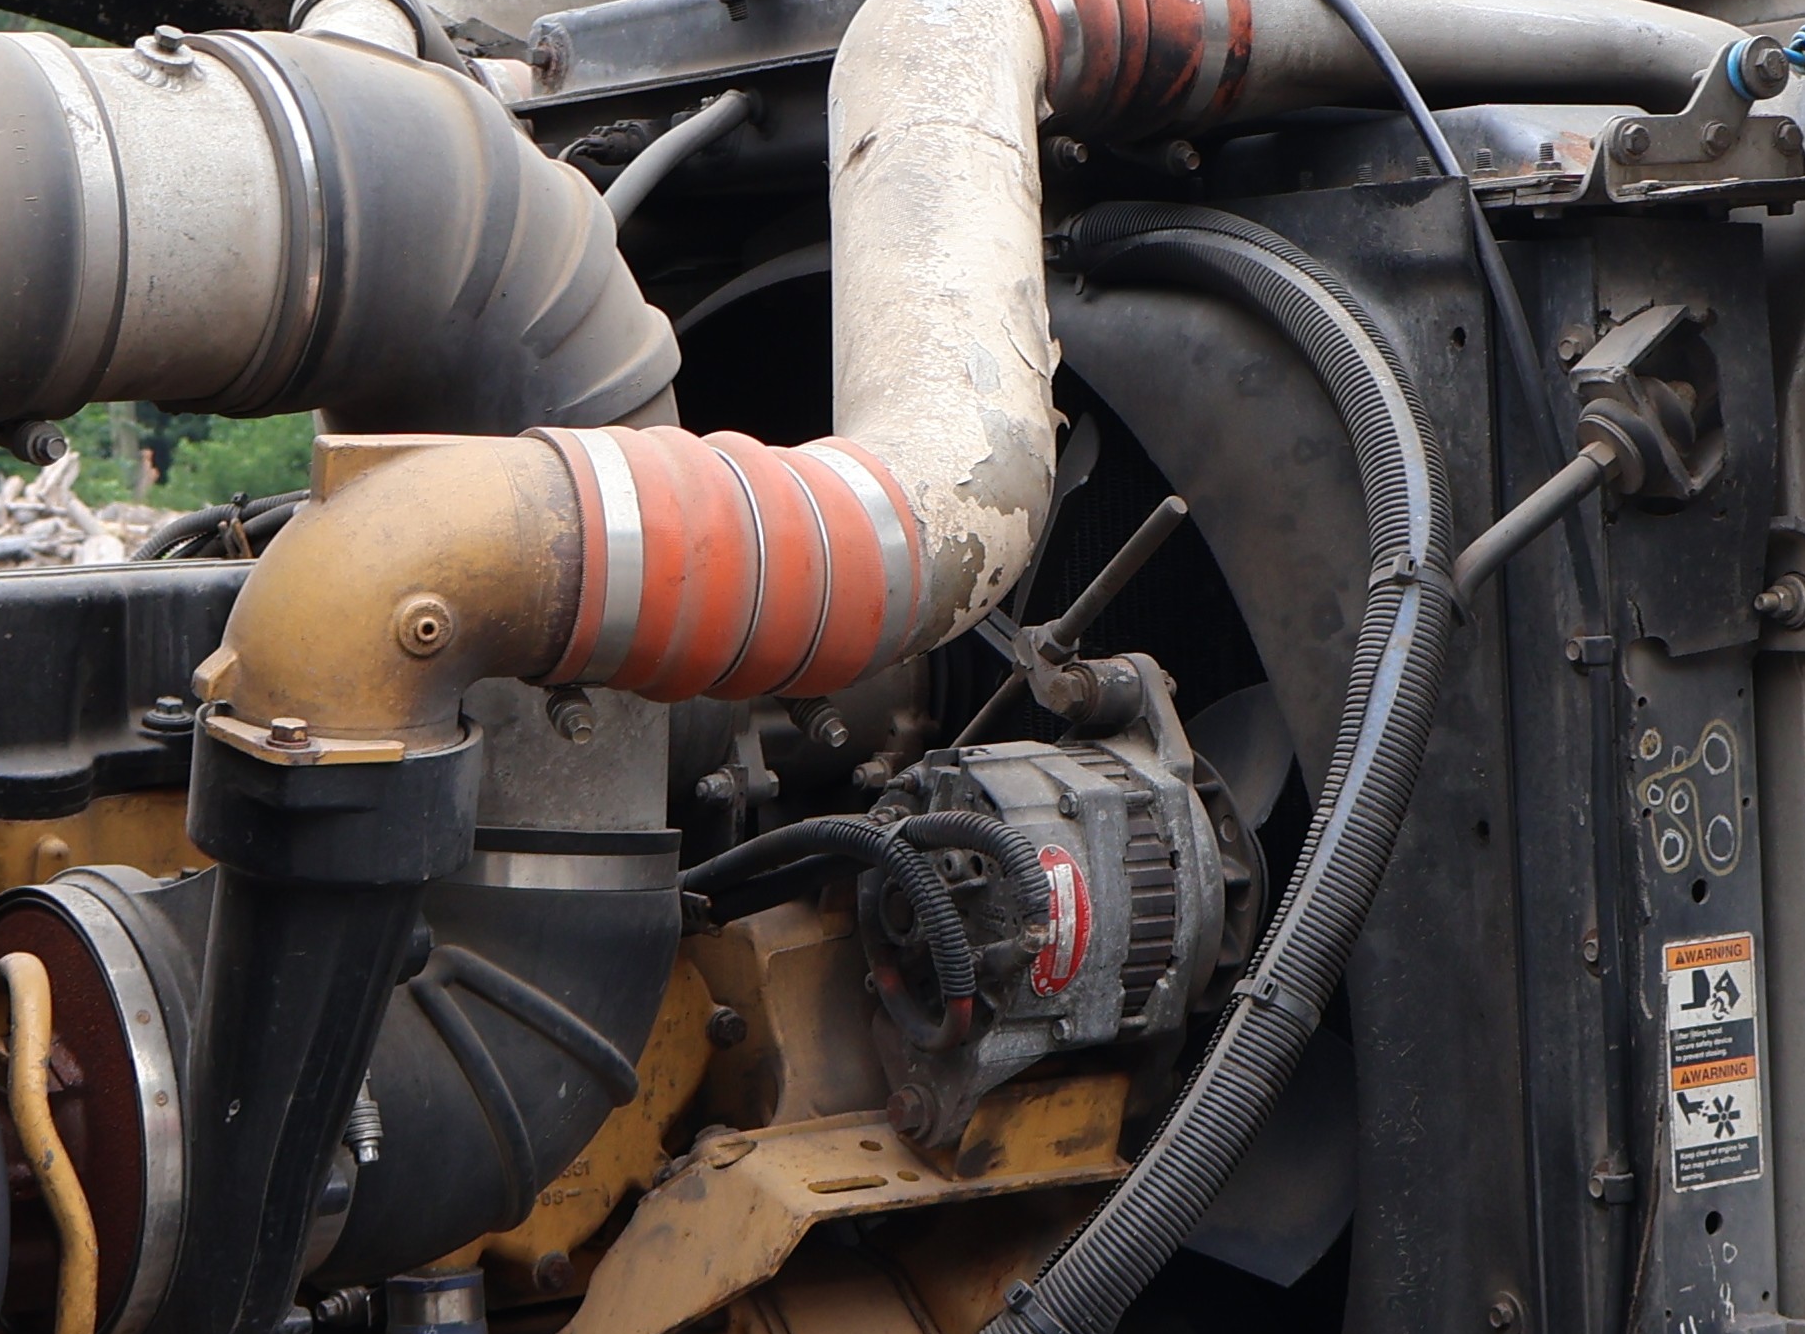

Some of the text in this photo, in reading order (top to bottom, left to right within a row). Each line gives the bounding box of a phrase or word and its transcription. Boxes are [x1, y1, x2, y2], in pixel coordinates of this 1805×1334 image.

[1683, 943, 1743, 964] WARNING
[1675, 1036, 1732, 1051] secure safety device
[1683, 1051, 1704, 1063] prevent
[1689, 1062, 1748, 1083] WARNING
[1680, 1151, 1694, 1161] Keep
[1696, 1148, 1709, 1158] clear
[1718, 1144, 1737, 1155] engine
[1680, 1153, 1741, 1171] Fan may start without
[1681, 1171, 1705, 1182] warning.
